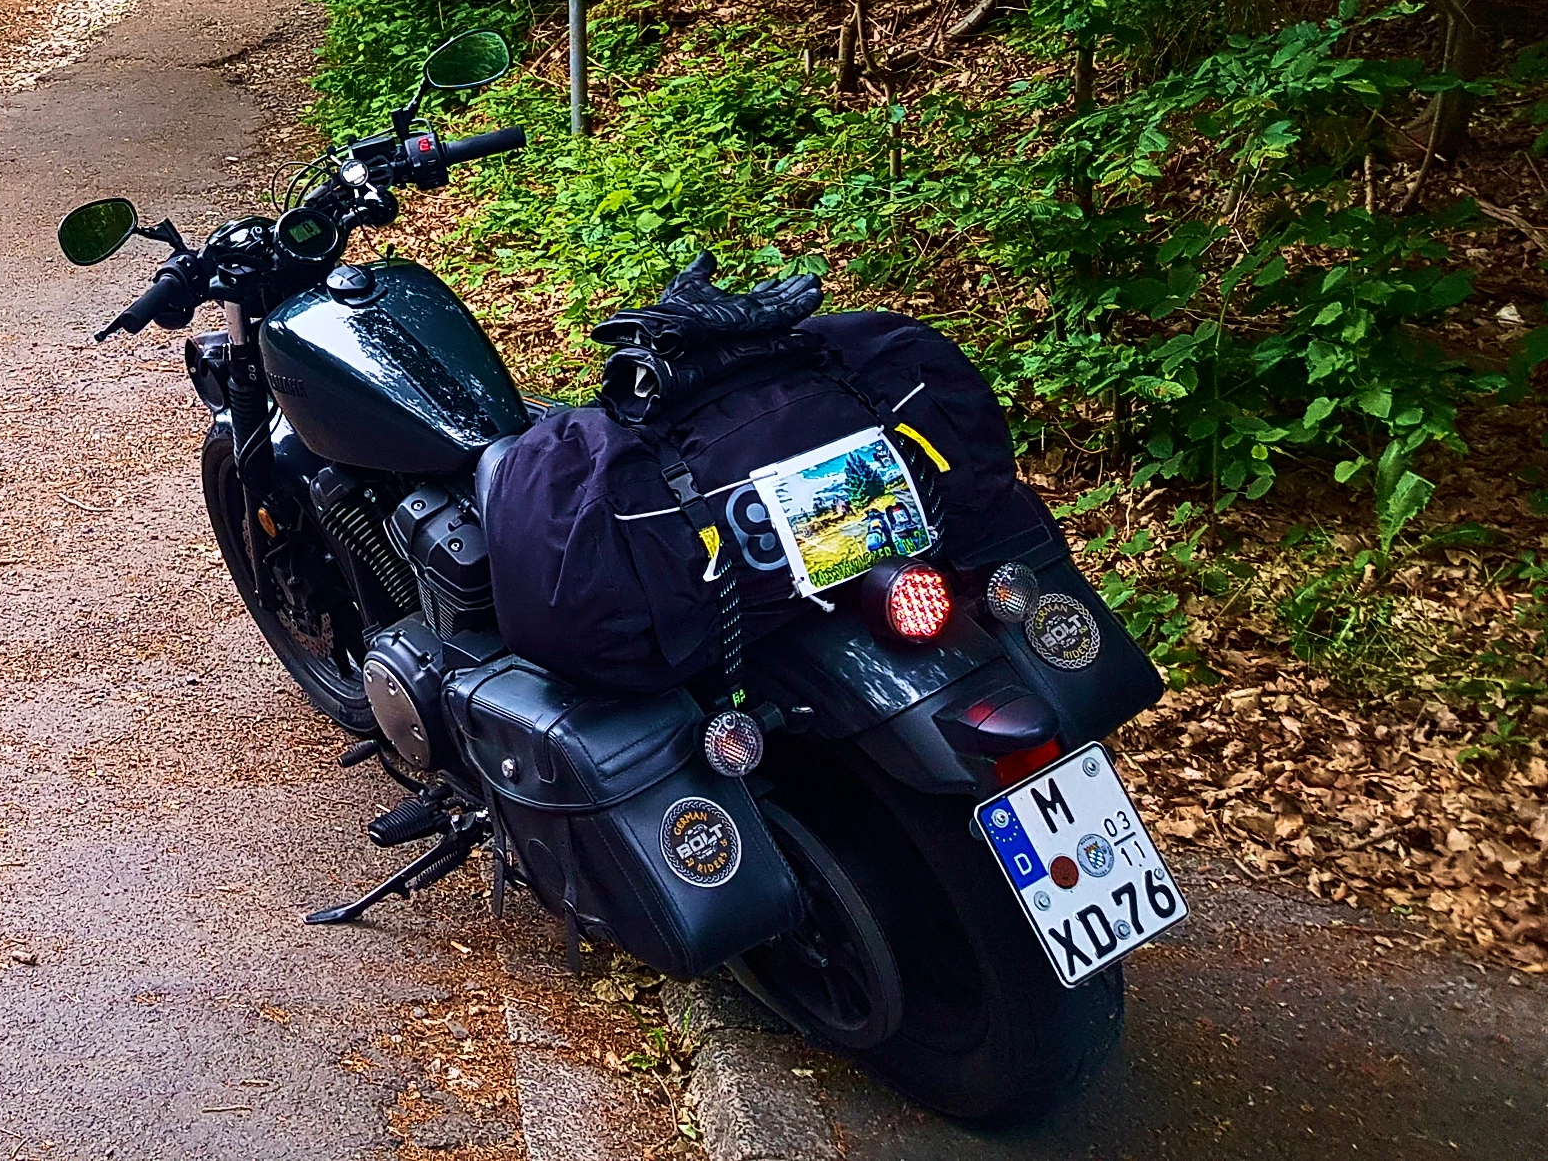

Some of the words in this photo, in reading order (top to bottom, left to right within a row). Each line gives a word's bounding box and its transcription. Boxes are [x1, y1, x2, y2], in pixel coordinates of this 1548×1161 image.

[1035, 604, 1068, 630] GERMAN
[1041, 614, 1081, 647] BOLT
[1063, 637, 1091, 659] RIDERS
[1030, 778, 1075, 833] M
[674, 811, 707, 836] GERMAN
[676, 823, 723, 859] BOLT
[697, 852, 728, 873] RIDERS
[1014, 853, 1032, 876] D
